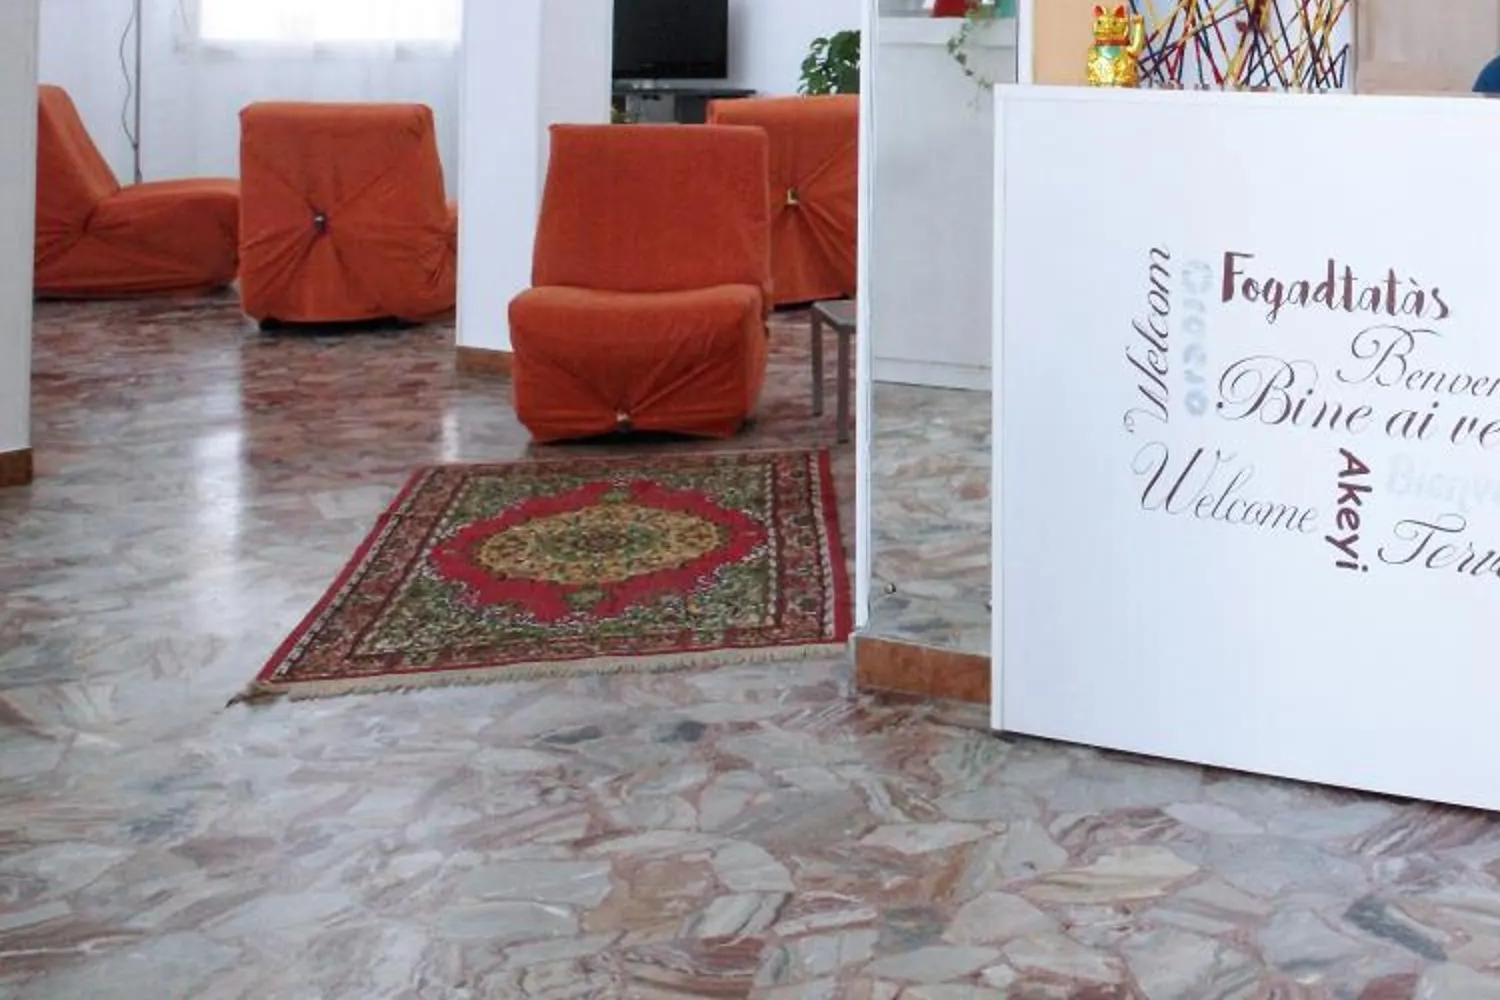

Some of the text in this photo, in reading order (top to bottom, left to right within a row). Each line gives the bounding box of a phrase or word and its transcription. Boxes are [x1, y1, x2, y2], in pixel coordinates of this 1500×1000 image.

[1222, 251, 1451, 324] Fogadtatàs
[1123, 244, 1171, 434] Welcom
[1216, 355, 1373, 435] Bine
[1385, 400, 1440, 440] ai
[1130, 441, 1320, 534] Welcome
[1325, 447, 1373, 573] Akeyi
